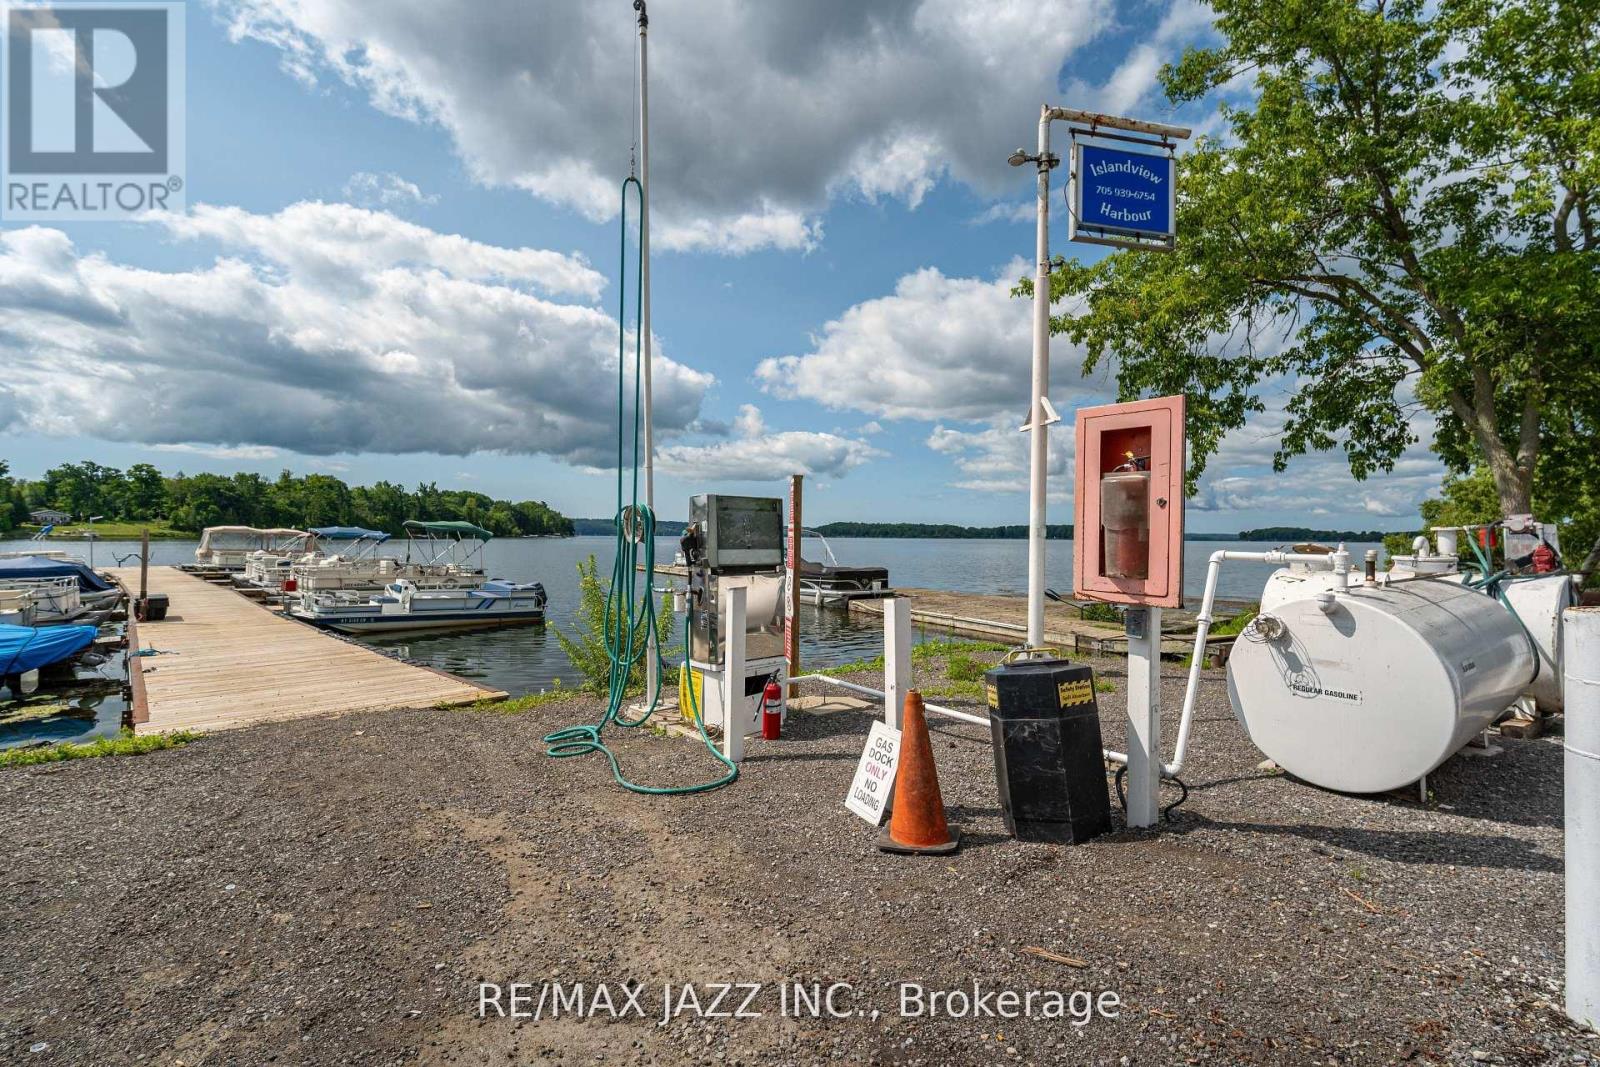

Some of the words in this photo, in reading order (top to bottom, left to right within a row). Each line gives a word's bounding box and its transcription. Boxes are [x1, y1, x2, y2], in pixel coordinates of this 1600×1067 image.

[1089, 159, 1163, 185] Islandview
[1095, 185, 1113, 196] 705
[1114, 187, 1156, 201] 939-6754
[1099, 202, 1152, 222] Harbour
[1292, 684, 1323, 695] REGULAR
[1324, 689, 1359, 701] GASOLINE
[875, 737, 894, 754] GAS
[868, 748, 894, 769] DOCK
[865, 761, 888, 781] ONLY
[864, 778, 878, 793] NO
[853, 786, 879, 811] LOADING
